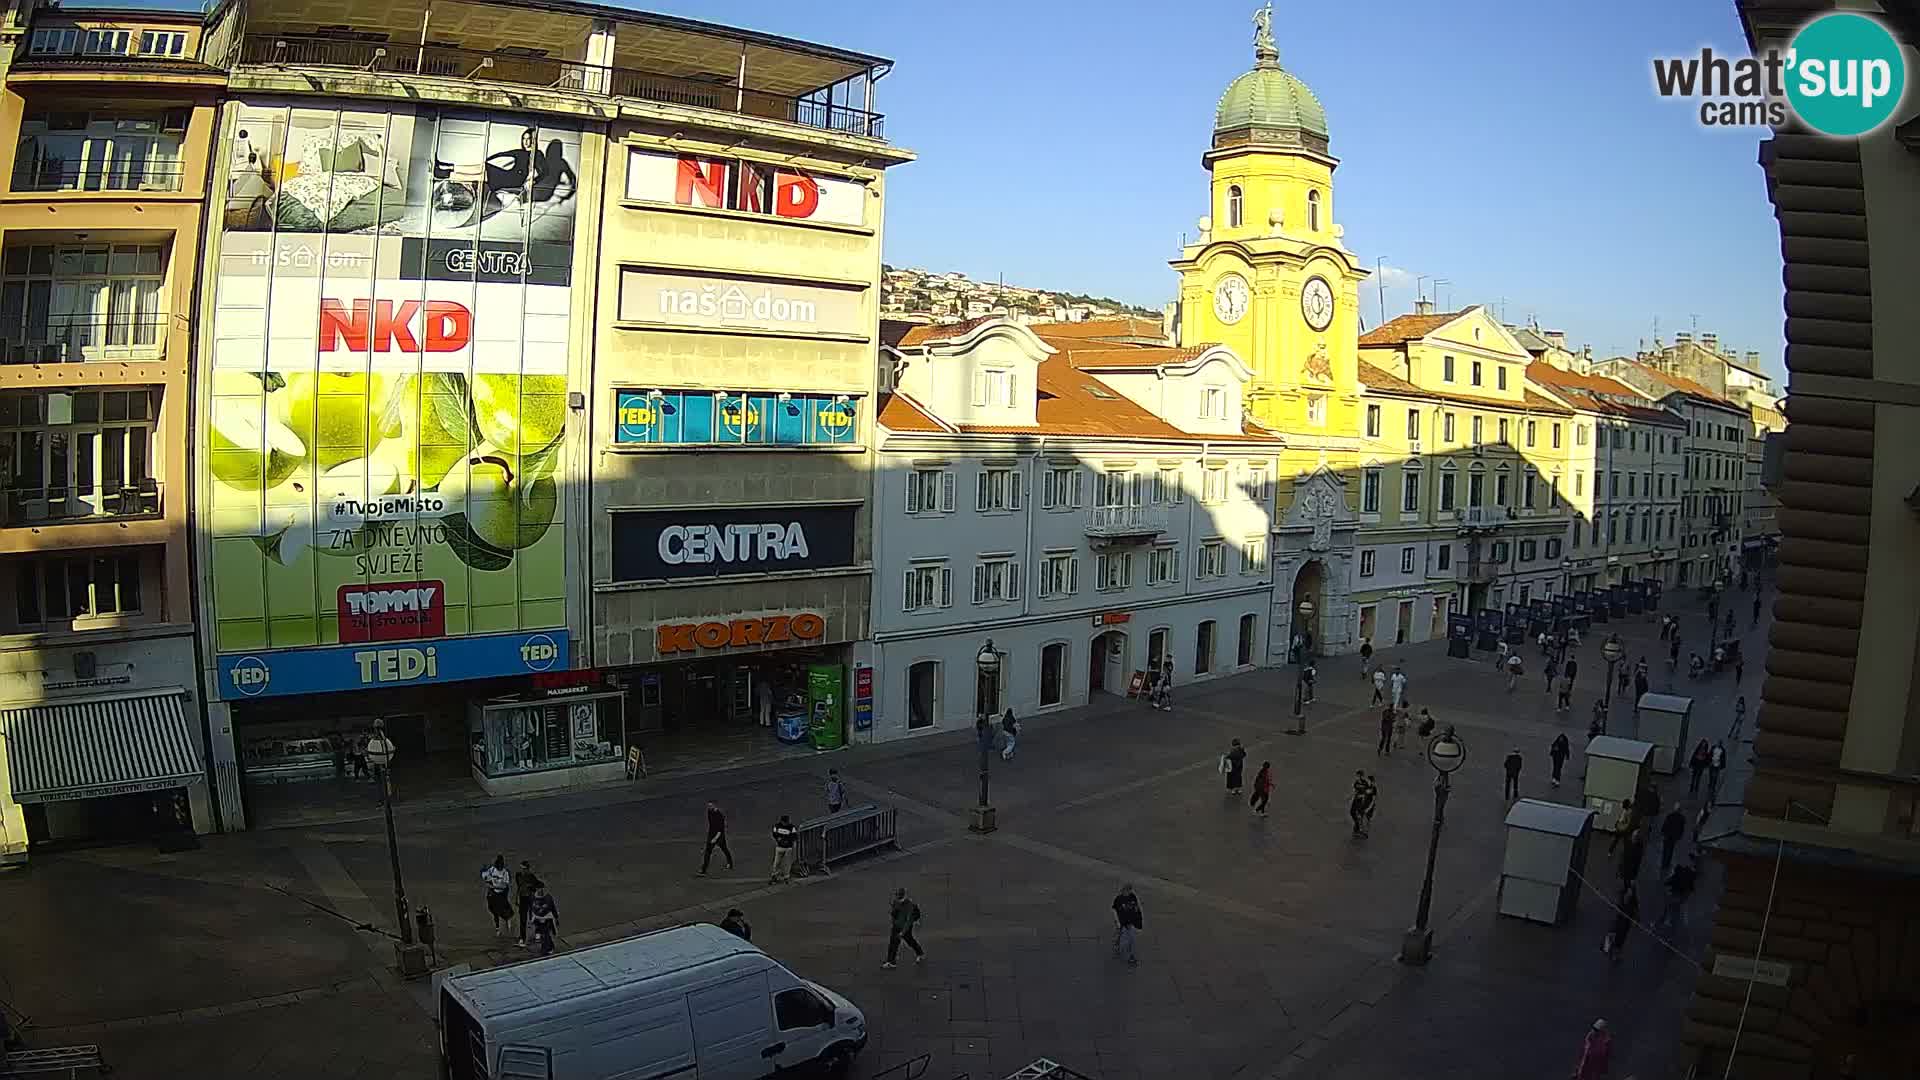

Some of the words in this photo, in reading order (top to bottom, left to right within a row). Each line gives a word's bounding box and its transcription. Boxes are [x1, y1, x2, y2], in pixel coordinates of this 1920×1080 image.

[675, 157, 819, 218] NKD
[446, 248, 533, 275] CENTRA
[658, 284, 718, 316] naš
[752, 290, 817, 323] dom
[318, 297, 473, 353] NKD
[618, 407, 656, 426] TEDi
[335, 498, 444, 517] #TvojeMisto
[329, 529, 355, 551] ZA
[362, 525, 449, 549] DNEVNO
[658, 522, 809, 565] CENTRA
[356, 548, 424, 576] SVJEŽE
[345, 587, 437, 616] TOMMY
[658, 613, 824, 654] KORZO
[355, 646, 438, 684] TEDi
[519, 644, 558, 662] TEDi
[230, 664, 271, 687] TEDi
